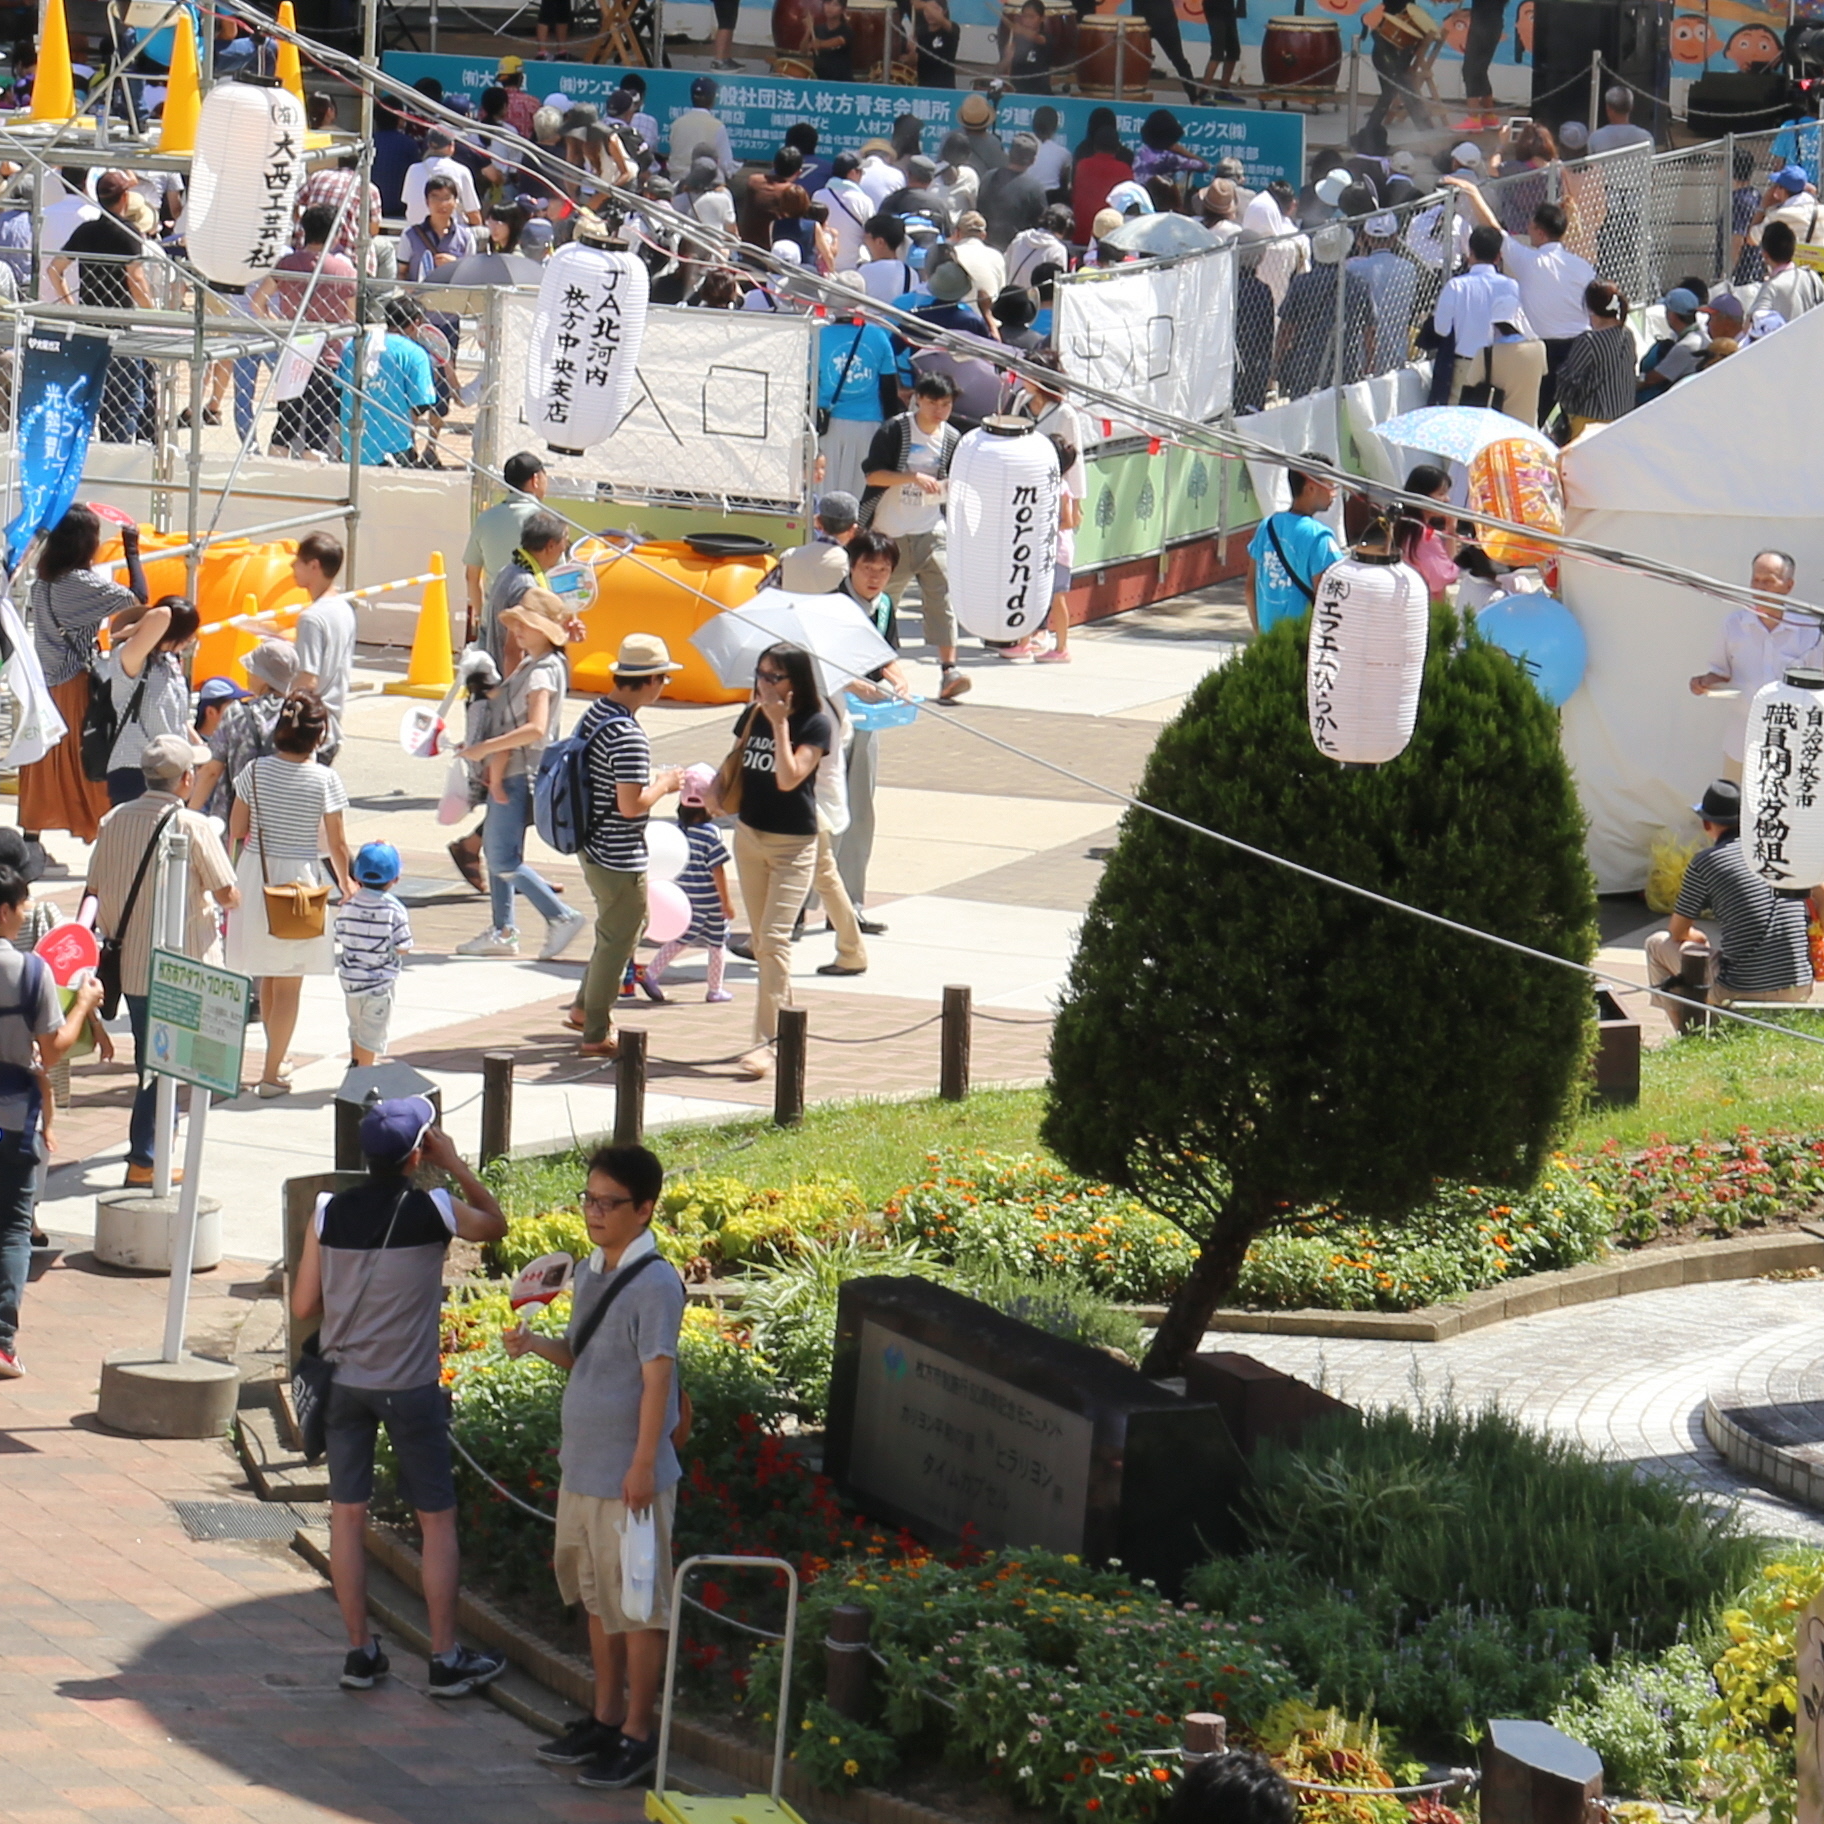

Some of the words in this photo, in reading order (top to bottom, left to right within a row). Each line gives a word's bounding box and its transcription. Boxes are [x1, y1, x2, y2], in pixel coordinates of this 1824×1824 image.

[715, 85, 950, 122] 般社団法人枚方青年会議所
[242, 103, 300, 270] (有)大西工芸社
[542, 284, 591, 425] 枚方中央支店
[584, 268, 626, 389] JA北河内
[1006, 485, 1038, 627] morondo
[1313, 577, 1351, 753] (株)エフエムひらかた
[743, 750, 776, 773] DIO
[1752, 704, 1798, 883] 職員関係労働組合
[1794, 704, 1824, 809] 自治労枚方市
